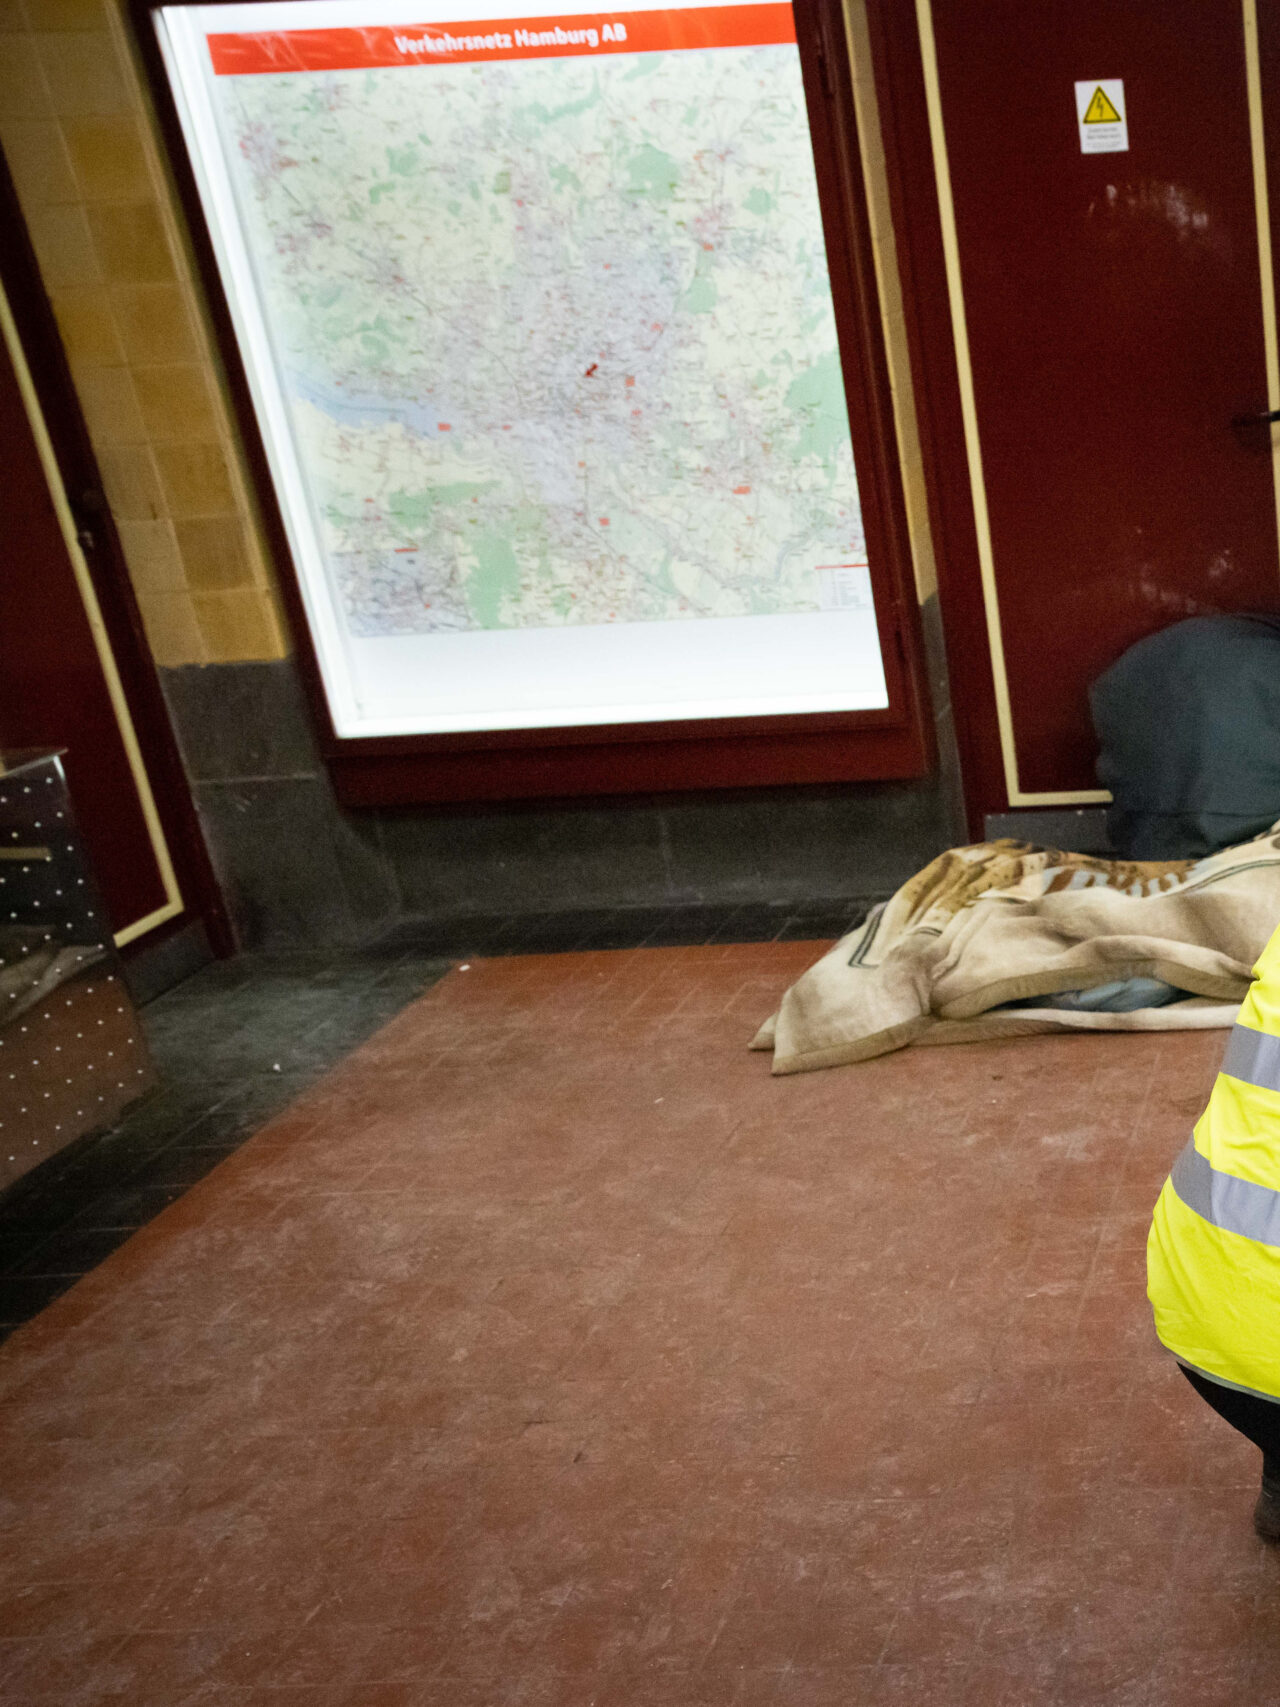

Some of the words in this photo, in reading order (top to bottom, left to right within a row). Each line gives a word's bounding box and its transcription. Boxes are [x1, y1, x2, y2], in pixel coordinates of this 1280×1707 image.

[394, 32, 513, 54] Verkehrsnetz
[514, 25, 599, 47] Hamburg
[601, 22, 628, 42] AB
